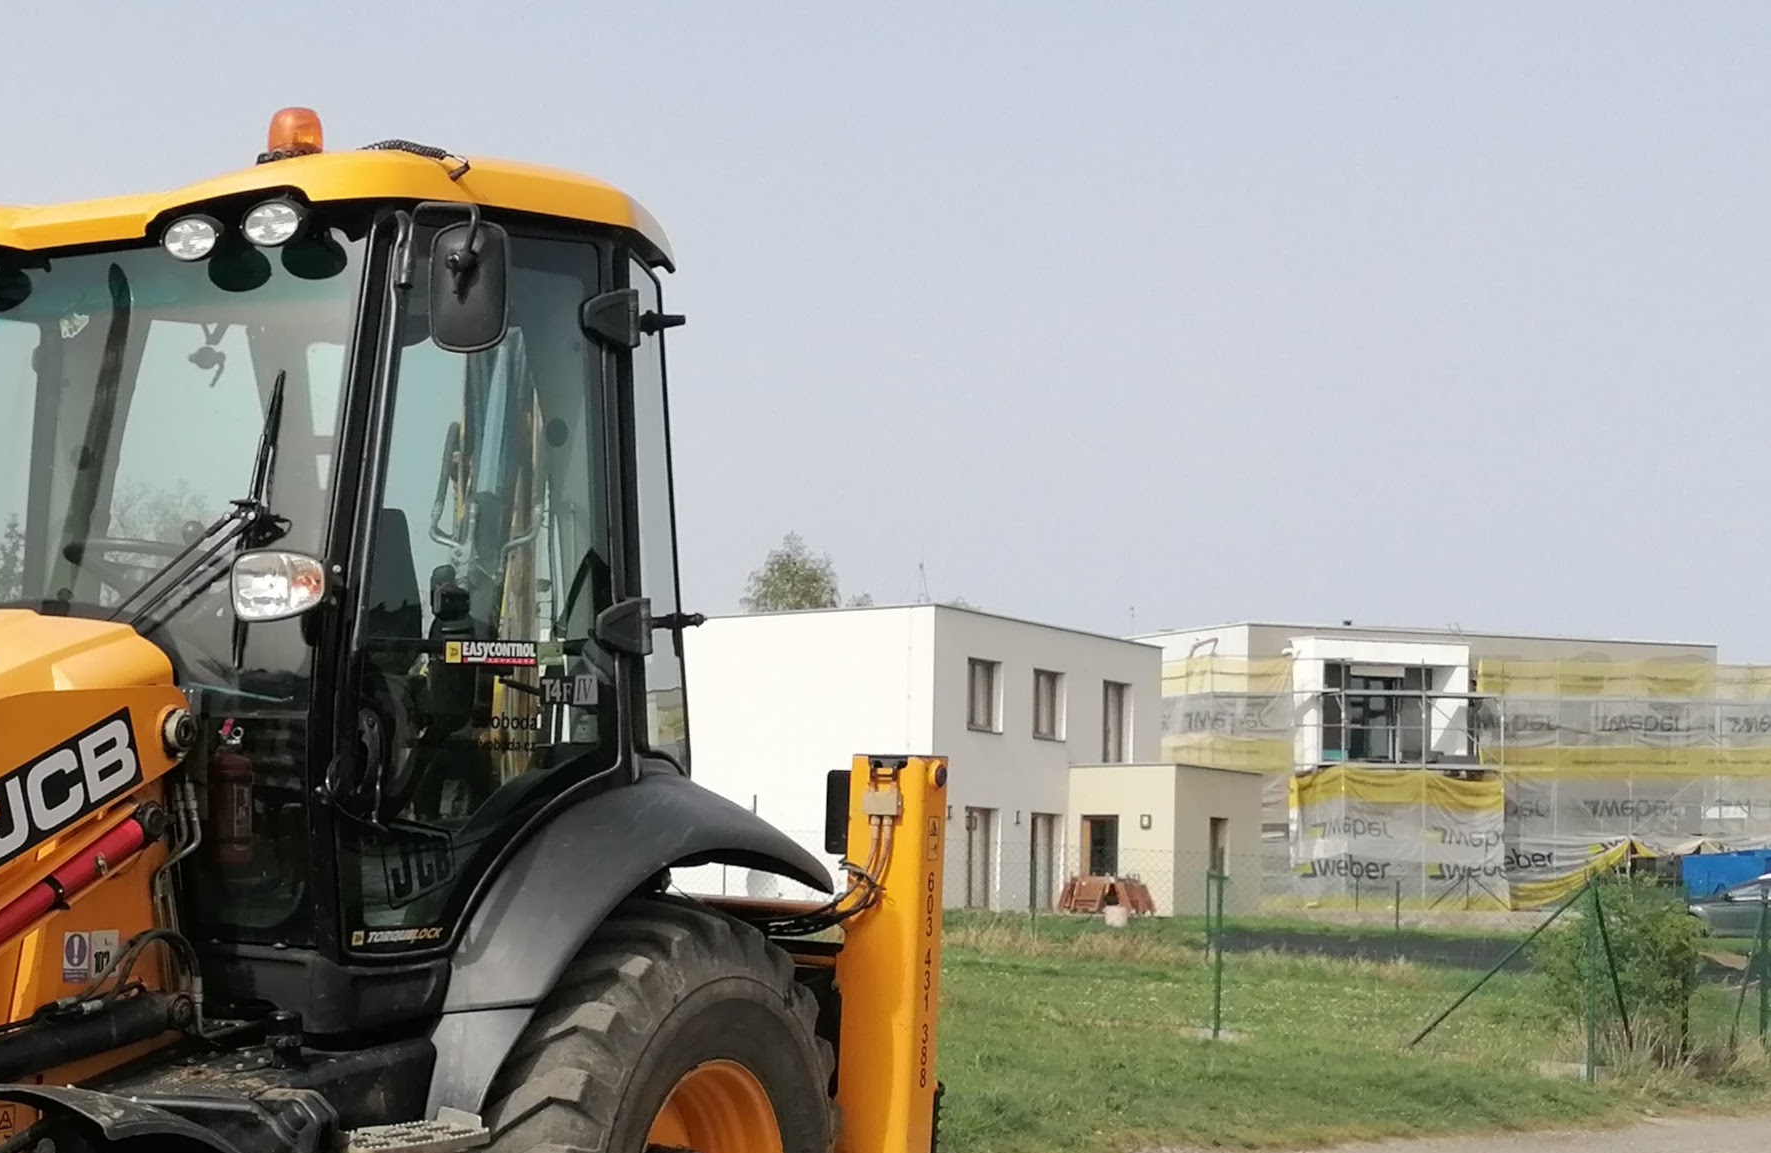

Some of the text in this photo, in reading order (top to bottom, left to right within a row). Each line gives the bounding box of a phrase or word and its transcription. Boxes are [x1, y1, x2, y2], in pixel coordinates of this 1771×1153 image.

[1317, 853, 1392, 880] weber
[919, 871, 935, 1089] 603 431 388
